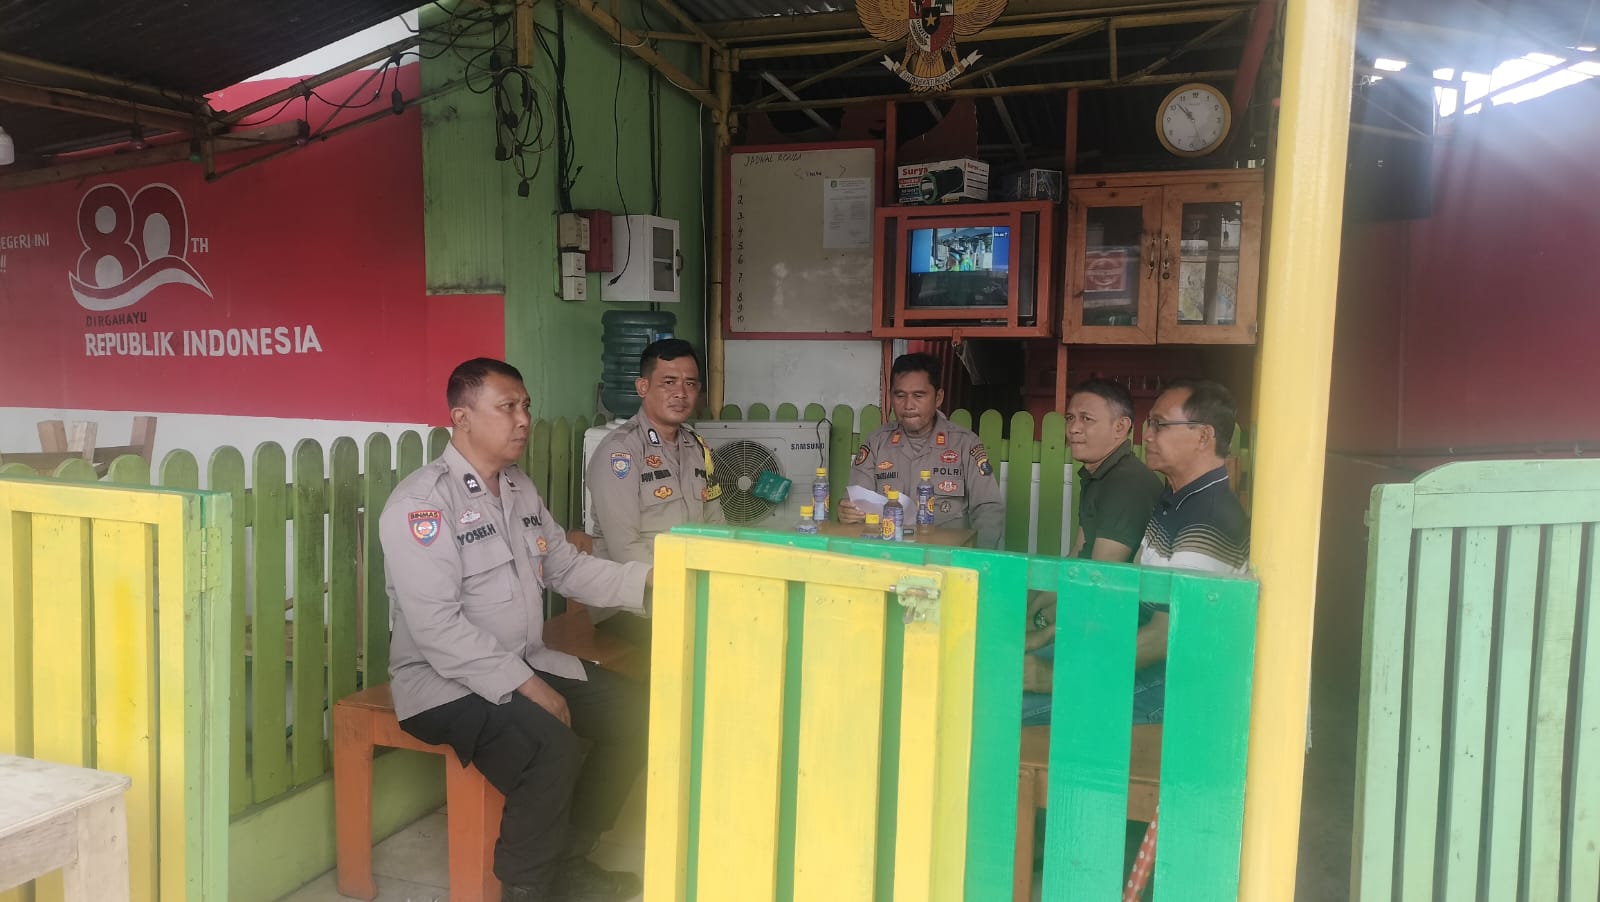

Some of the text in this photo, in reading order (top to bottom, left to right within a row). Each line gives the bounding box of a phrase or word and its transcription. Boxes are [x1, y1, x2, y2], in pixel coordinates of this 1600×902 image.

[902, 167, 929, 176] Surya
[0, 232, 49, 250] EGERI INI
[191, 237, 209, 253] TH
[86, 311, 148, 327] DIRGAHAYU
[84, 325, 323, 357] REPUBLIK INDONESIA
[932, 467, 962, 476] POLRI
